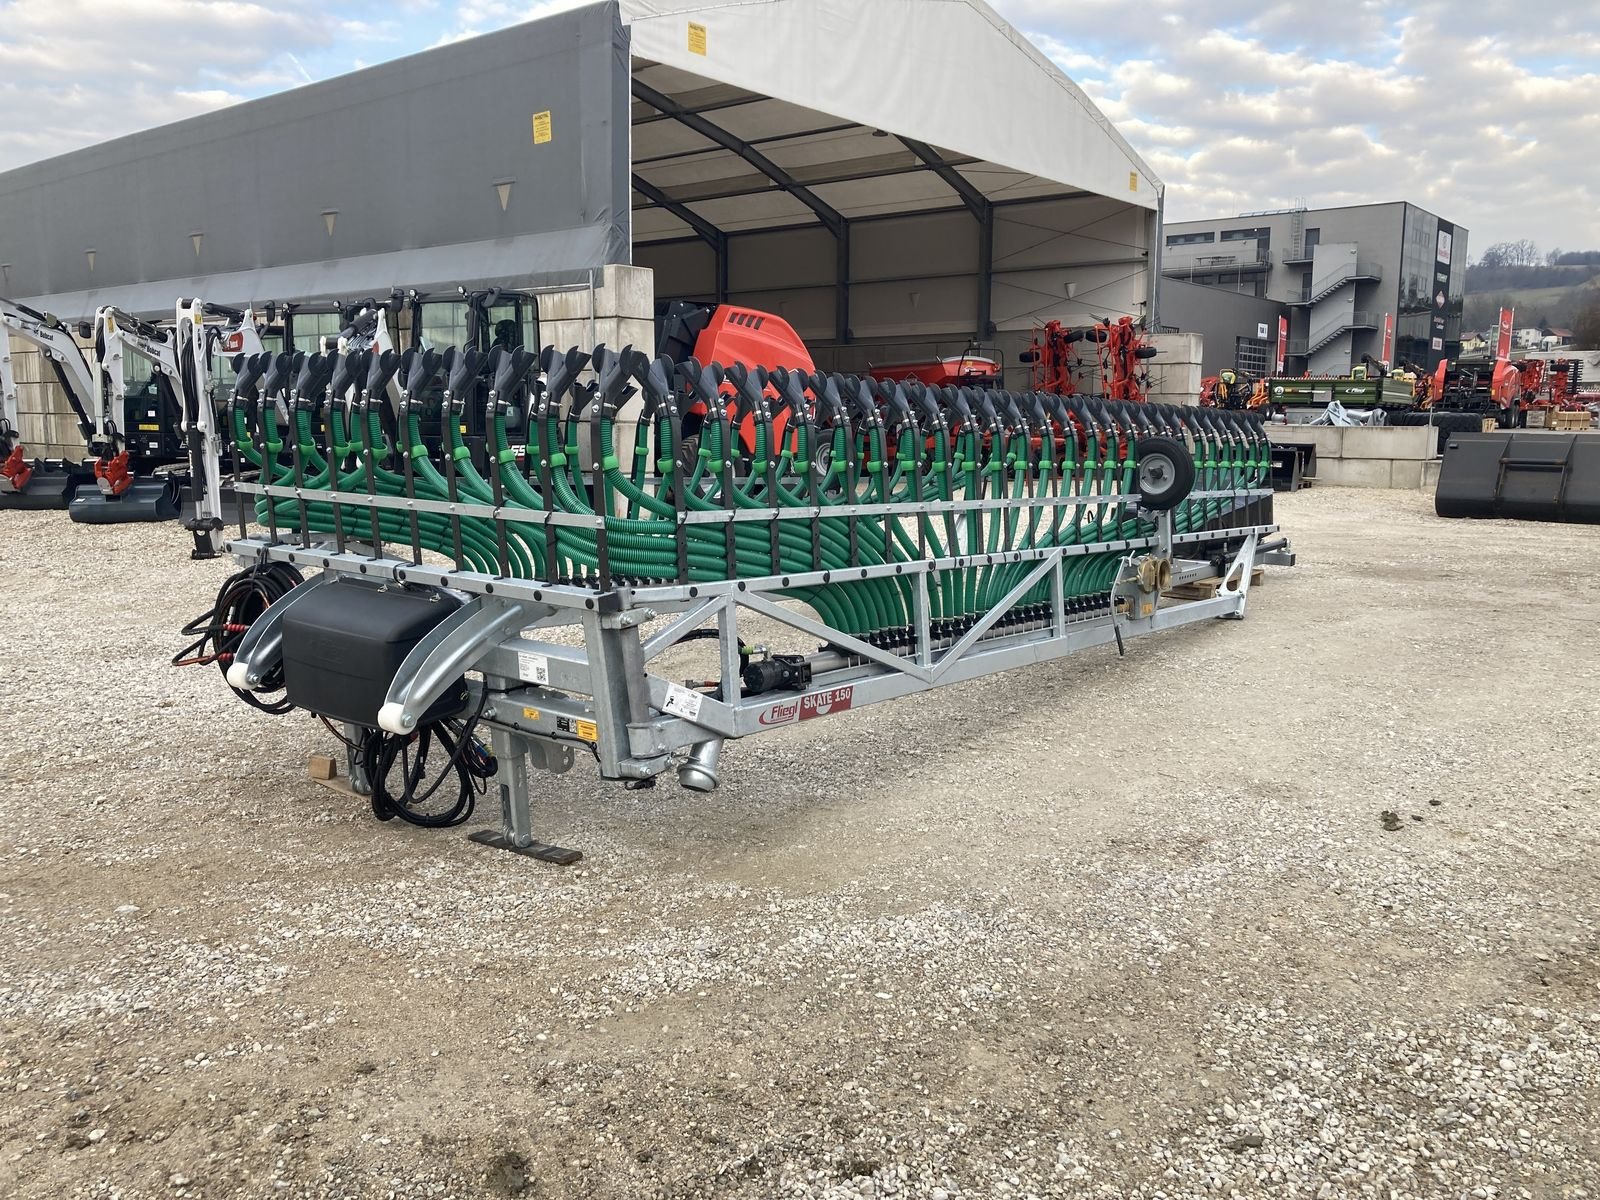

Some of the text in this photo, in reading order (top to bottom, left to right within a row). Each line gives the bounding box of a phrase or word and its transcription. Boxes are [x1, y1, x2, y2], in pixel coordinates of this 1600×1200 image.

[40, 331, 54, 341] Bobcat
[147, 345, 161, 357] Bobcat
[803, 686, 852, 709] SKATE 150
[768, 701, 798, 721] Fliegl
